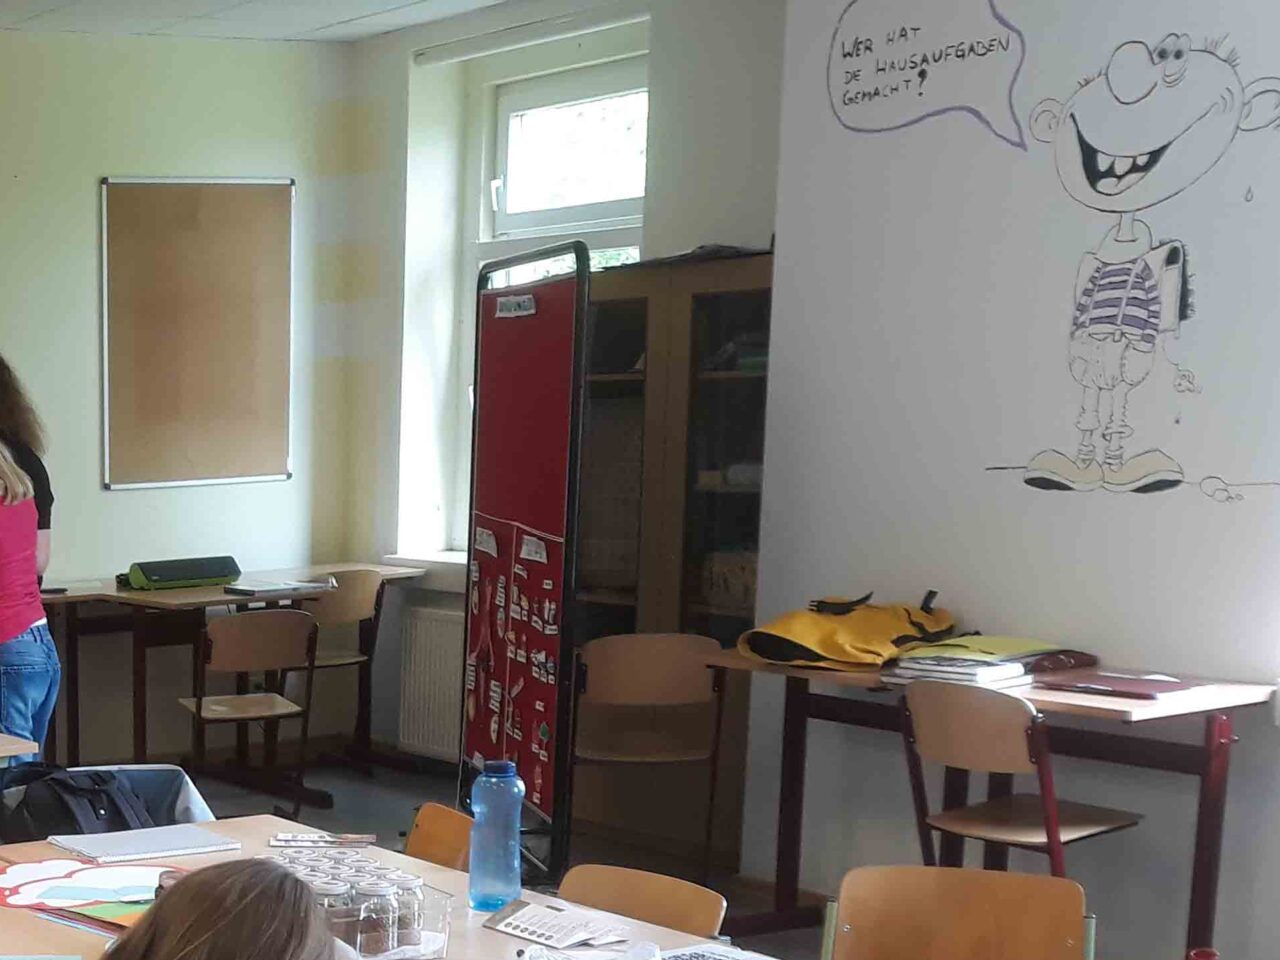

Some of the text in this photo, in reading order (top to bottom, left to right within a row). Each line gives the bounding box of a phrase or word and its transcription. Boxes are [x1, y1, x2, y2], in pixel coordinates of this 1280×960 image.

[841, 26, 921, 58] WER HAT
[875, 34, 1010, 75] HAUSAUFGABEN
